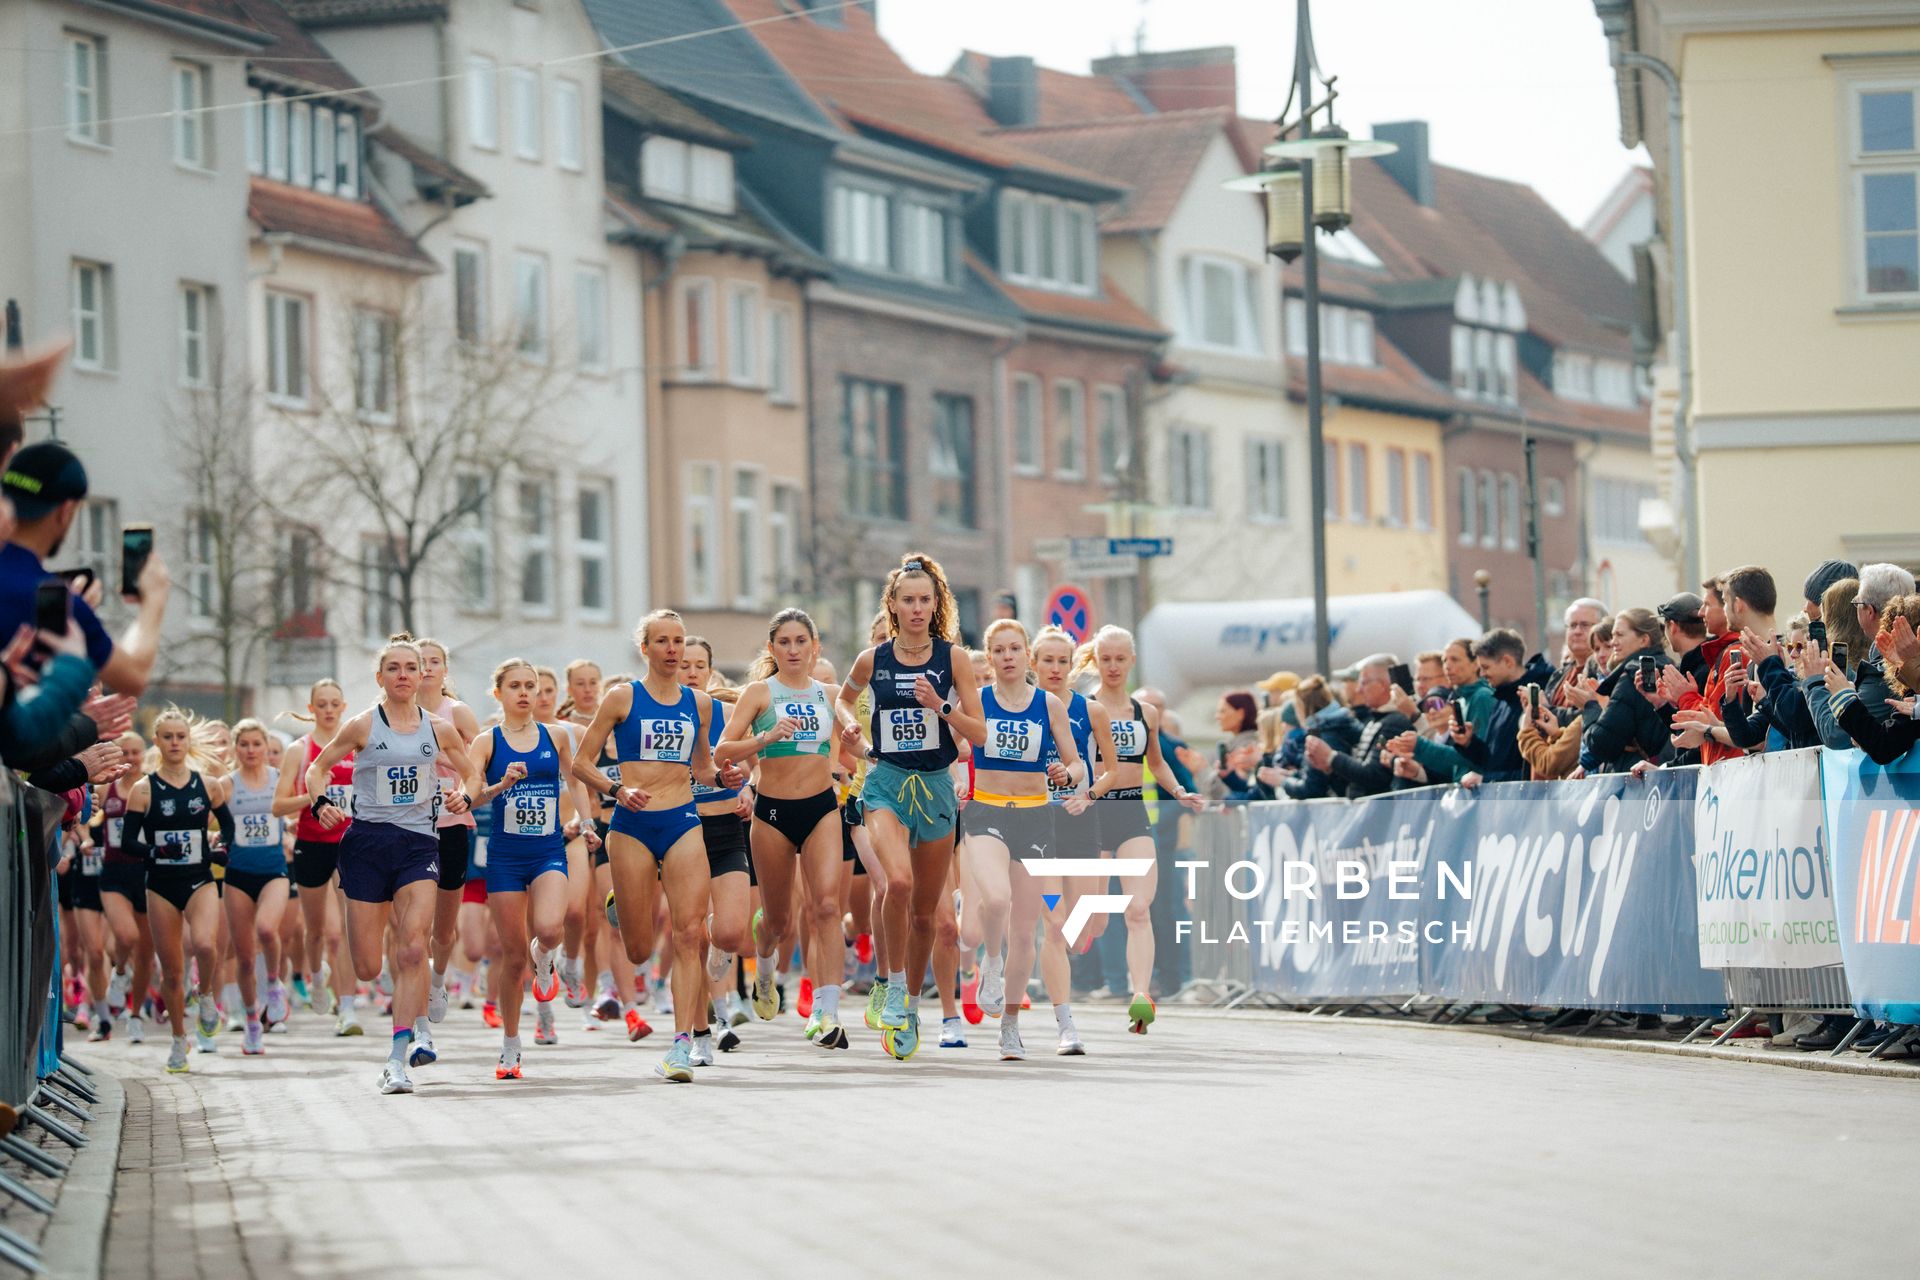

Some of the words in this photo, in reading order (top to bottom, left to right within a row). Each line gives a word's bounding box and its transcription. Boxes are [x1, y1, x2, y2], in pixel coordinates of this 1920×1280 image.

[1221, 613, 1345, 652] myciy
[785, 703, 816, 716] GLS
[890, 709, 924, 724] GLS
[651, 720, 683, 734] GLS
[789, 716, 820, 731] 08
[996, 721, 1029, 735] GLS
[892, 723, 927, 741] 659
[1112, 732, 1136, 746] 291
[653, 734, 684, 750] 227
[996, 733, 1029, 751] 930
[387, 766, 417, 779] GLS
[326, 786, 345, 797] LS
[389, 779, 418, 795] 180
[515, 797, 546, 810] GLS
[243, 815, 268, 825] GLS
[516, 809, 546, 826] 933
[245, 825, 270, 838] 228
[1462, 784, 1638, 998] mycity
[1783, 919, 1839, 945] OFFICE
